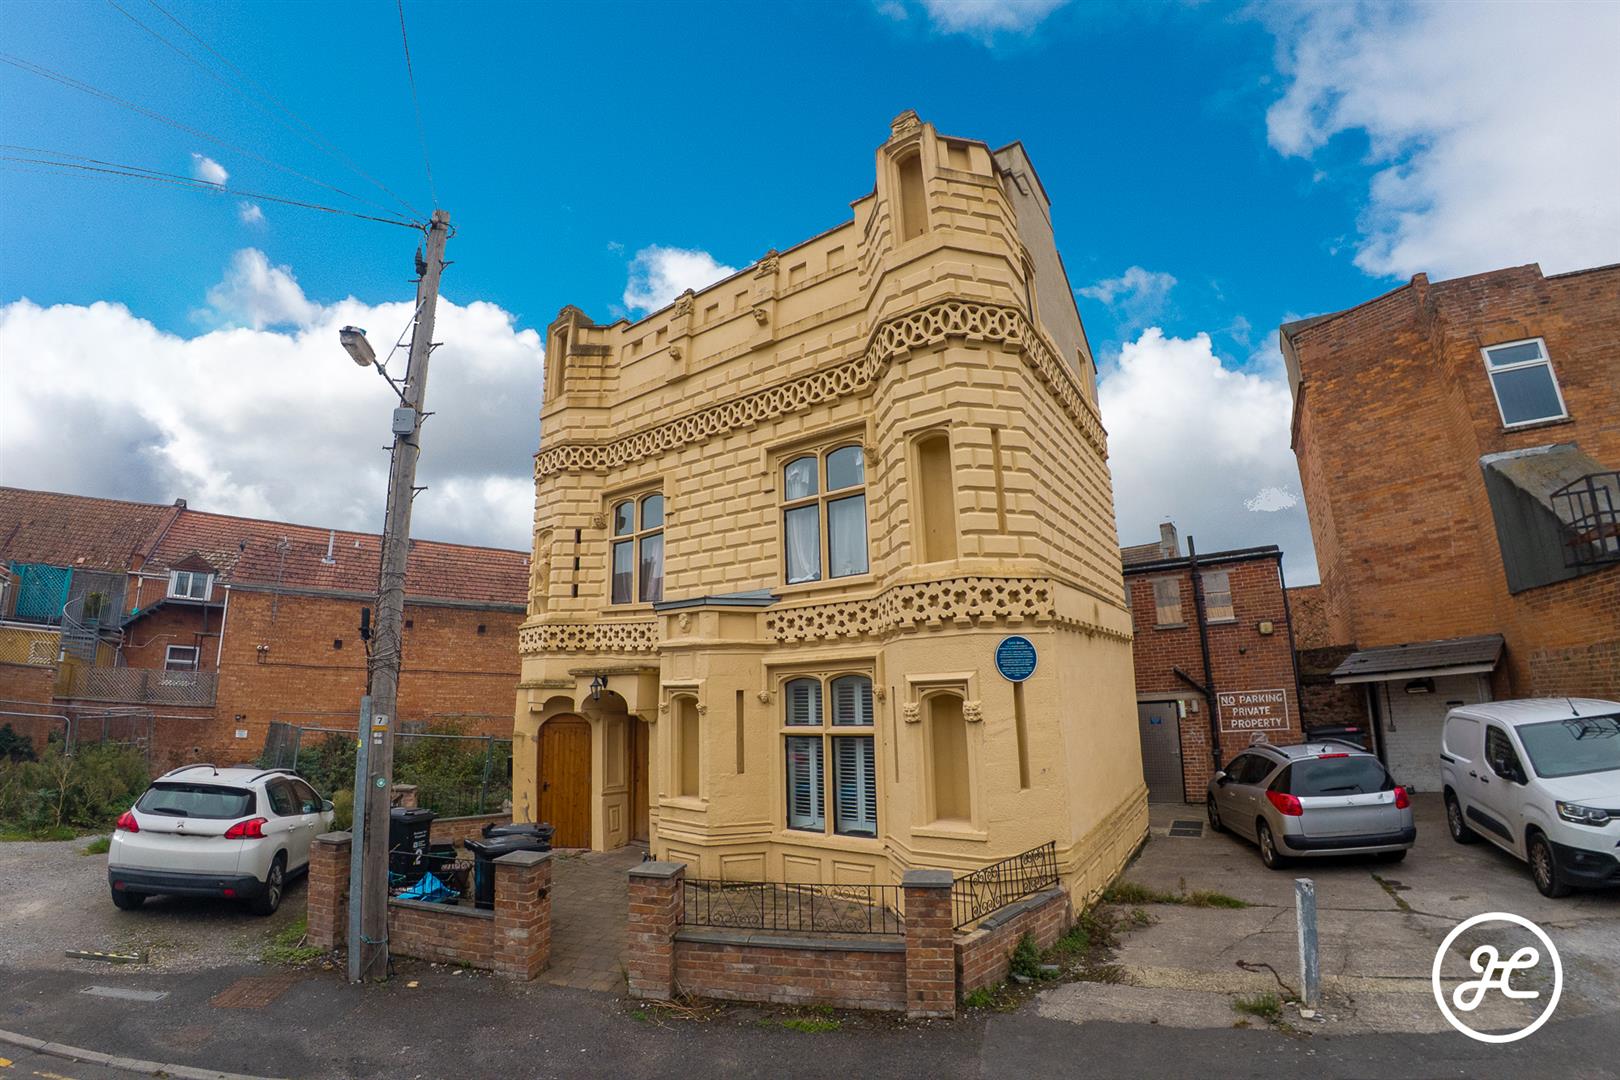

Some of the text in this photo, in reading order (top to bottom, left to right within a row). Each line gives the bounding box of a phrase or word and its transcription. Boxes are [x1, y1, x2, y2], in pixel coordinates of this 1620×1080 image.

[1221, 693, 1283, 705] NO PARKING
[1232, 706, 1271, 716] PRIVATE
[1231, 718, 1282, 728] PROPERTY
